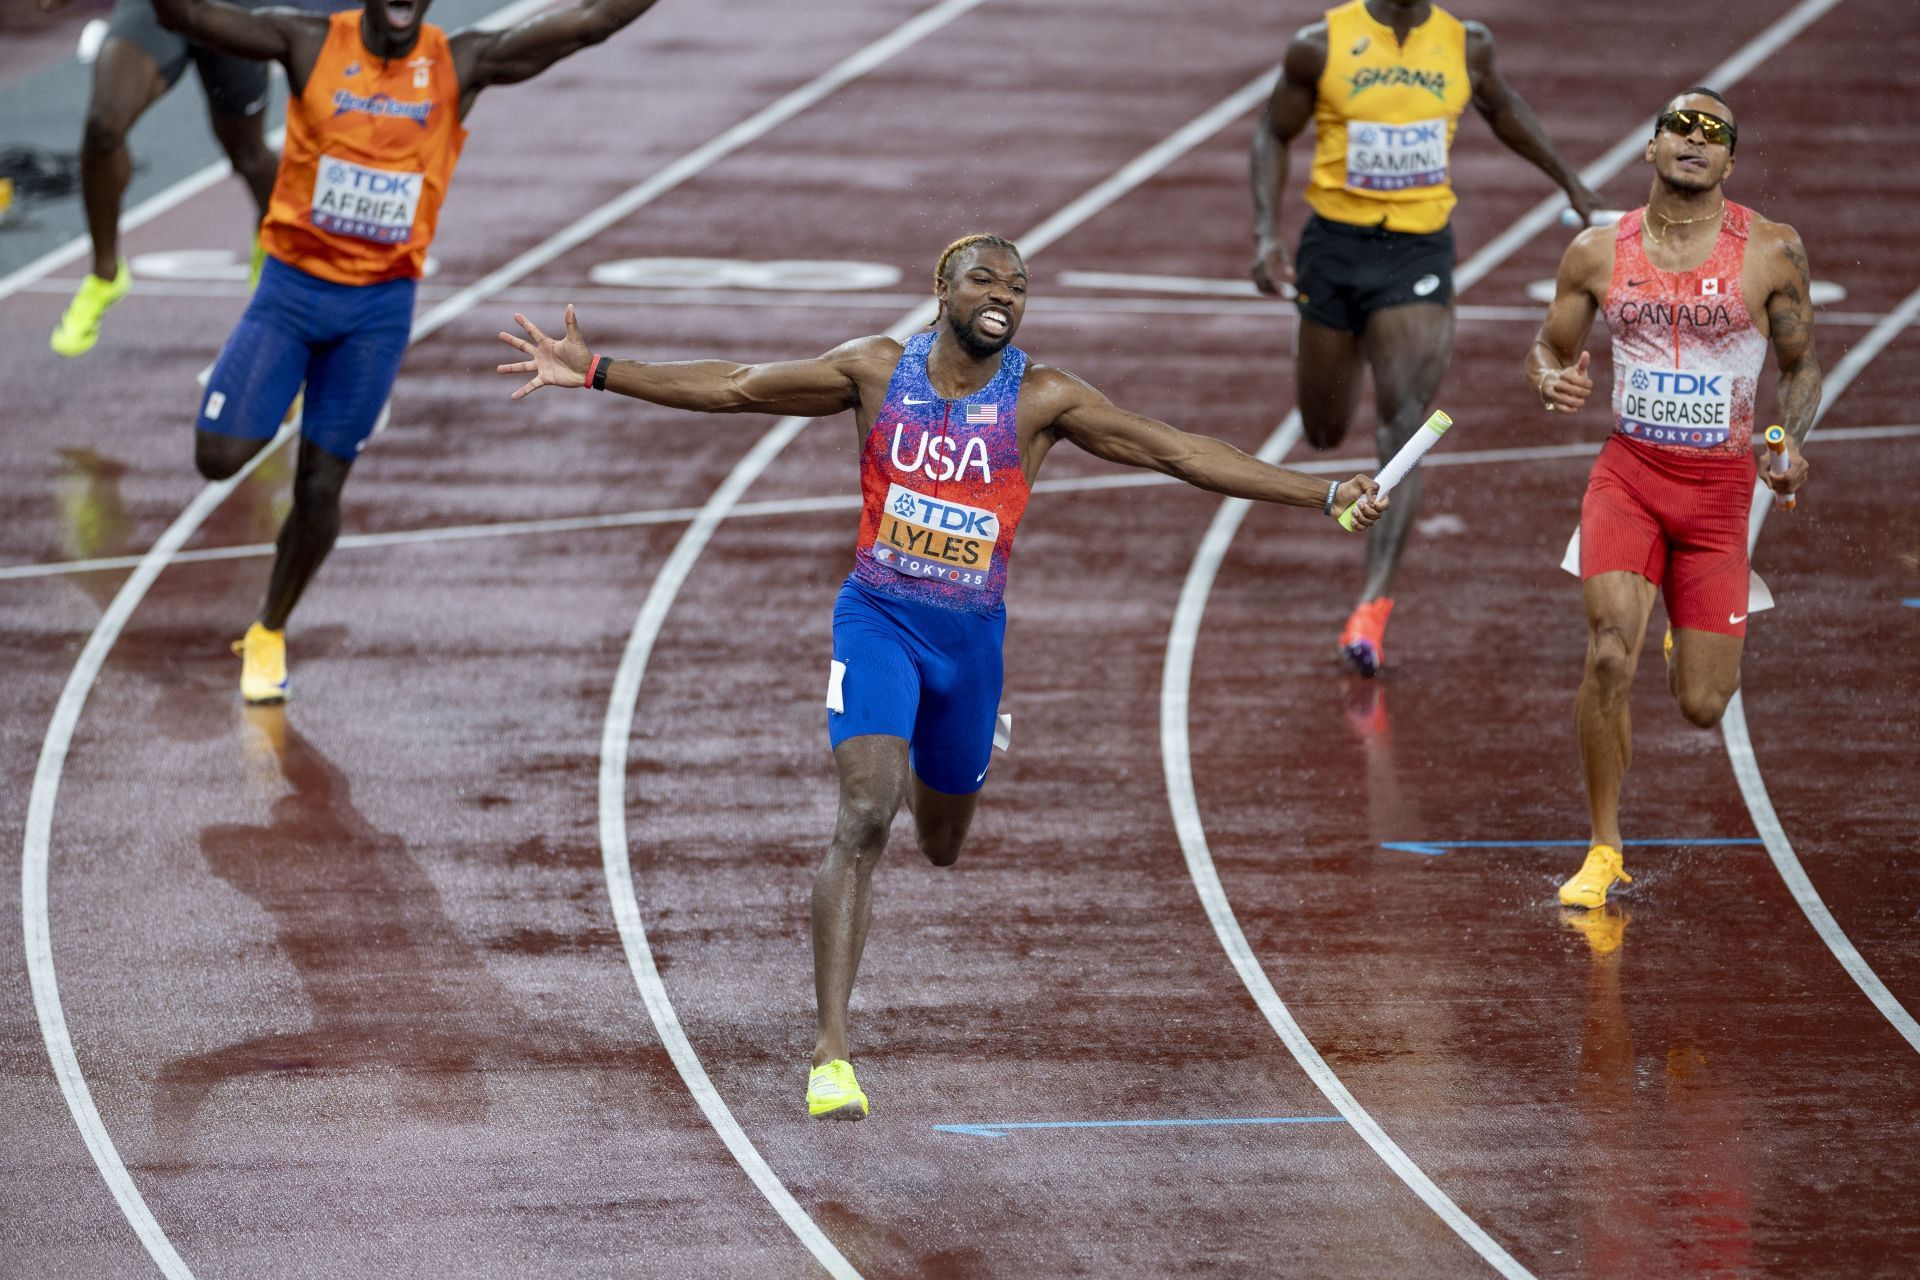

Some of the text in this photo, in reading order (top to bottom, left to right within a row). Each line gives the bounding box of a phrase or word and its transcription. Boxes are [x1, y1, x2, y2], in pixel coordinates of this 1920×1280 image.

[1352, 67, 1445, 89] GHANA
[1380, 123, 1438, 146] TDK
[350, 168, 411, 195] TDK
[320, 189, 407, 221] AFRIFA
[1620, 302, 1731, 327] CANADA
[1650, 371, 1723, 396] TDK
[1626, 394, 1725, 424] DE GRASSE
[891, 422, 991, 484] USA
[917, 498, 995, 536] TDK
[889, 521, 980, 565] LYLES
